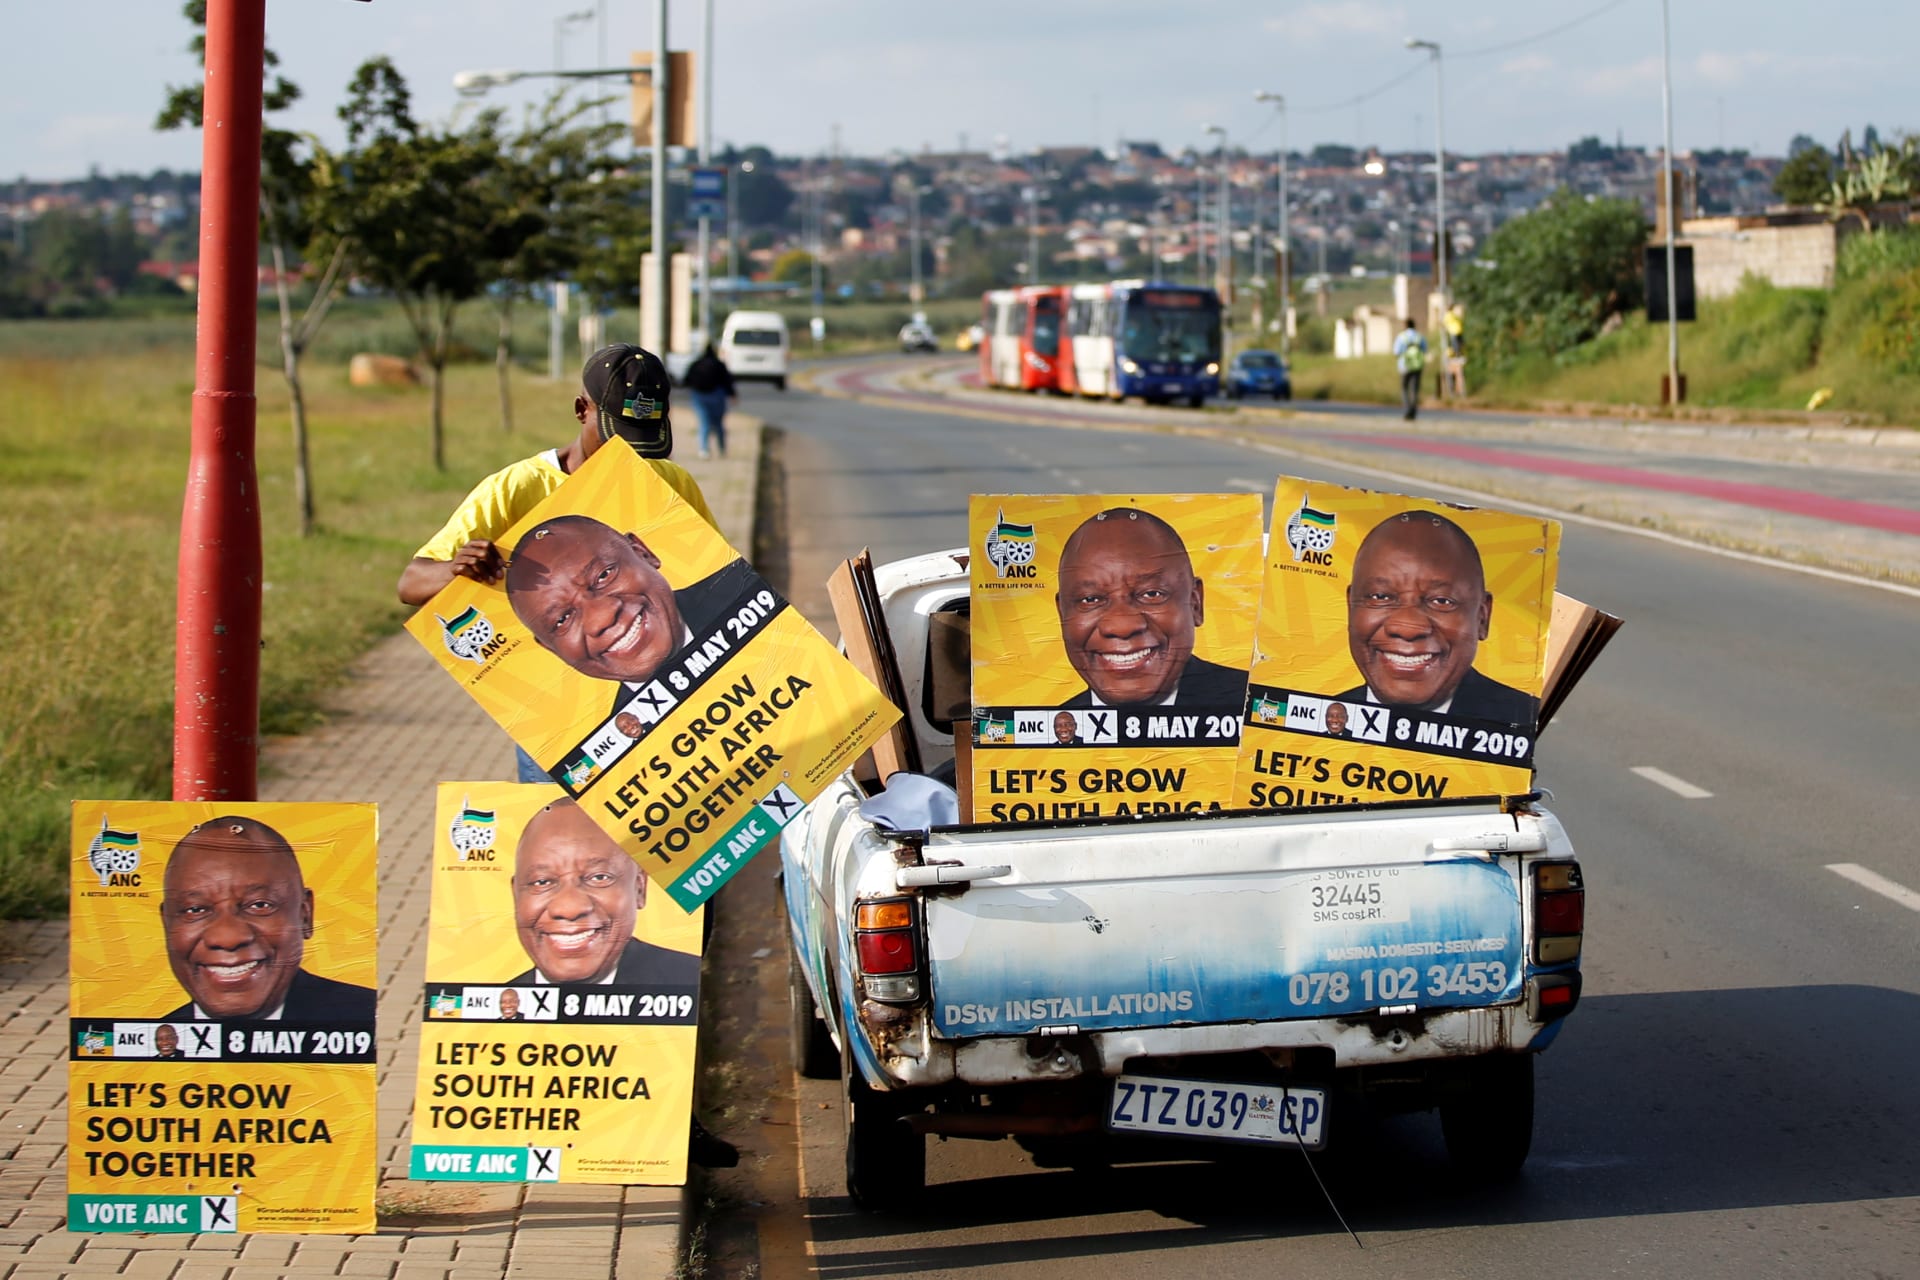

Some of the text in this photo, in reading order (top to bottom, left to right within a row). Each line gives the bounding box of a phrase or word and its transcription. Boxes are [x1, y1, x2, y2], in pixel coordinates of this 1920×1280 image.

[1302, 550, 1333, 566] ANC
[1006, 565, 1037, 578] ANC
[481, 633, 507, 660] ANC
[593, 736, 617, 760] ANC
[668, 670, 690, 691] 8
[683, 629, 731, 679] MAY
[727, 590, 776, 640] 2019
[1018, 720, 1044, 733] ANC
[1125, 716, 1141, 739] 8
[1147, 716, 1199, 739] MAY
[1204, 715, 1243, 738] 201
[1290, 704, 1317, 720] ANC
[1395, 718, 1410, 740] 8
[1416, 721, 1468, 749] MAY
[1472, 730, 1529, 759] 2019
[604, 674, 757, 819] LET'S GROW
[628, 675, 813, 843] SOUTH AFRICA
[990, 768, 1187, 793] LET'S GROW
[1254, 748, 1449, 798] LET'S GROW
[648, 744, 784, 864] TOGETHER
[1249, 782, 1359, 807] SOU
[467, 849, 496, 861] ANC
[682, 852, 731, 896] VOTE
[726, 819, 766, 860] ANC
[109, 873, 142, 887] ANC
[1312, 883, 1381, 908] 32445
[1313, 910, 1339, 922] SMS
[1342, 909, 1365, 921] cost
[1380, 940, 1443, 957] DOMESTIC
[1289, 960, 1507, 1006] 078 102 3453
[466, 996, 490, 1009] ANC
[564, 994, 579, 1016] 8
[584, 995, 635, 1017] MAY
[638, 995, 693, 1017] 2019
[945, 990, 1193, 1025] DStv INSTALLATIONS
[118, 1033, 145, 1045] ANC
[228, 1030, 245, 1053] 8
[251, 1031, 306, 1053] MAY
[311, 1031, 371, 1054] 2019
[435, 1042, 618, 1067] LET'S GROW
[88, 1082, 291, 1109] LET'S GROW
[432, 1074, 651, 1100] SOUTH AFRICA
[430, 1105, 581, 1130] TOGETHER
[1278, 1096, 1319, 1136] GP
[86, 1117, 332, 1144] SOUTH AFRICA
[85, 1151, 256, 1177] TOGETHER
[424, 1153, 472, 1173] VOTE
[476, 1153, 517, 1174] ANC
[84, 1203, 137, 1224] VOTE
[144, 1204, 188, 1224] ANC
